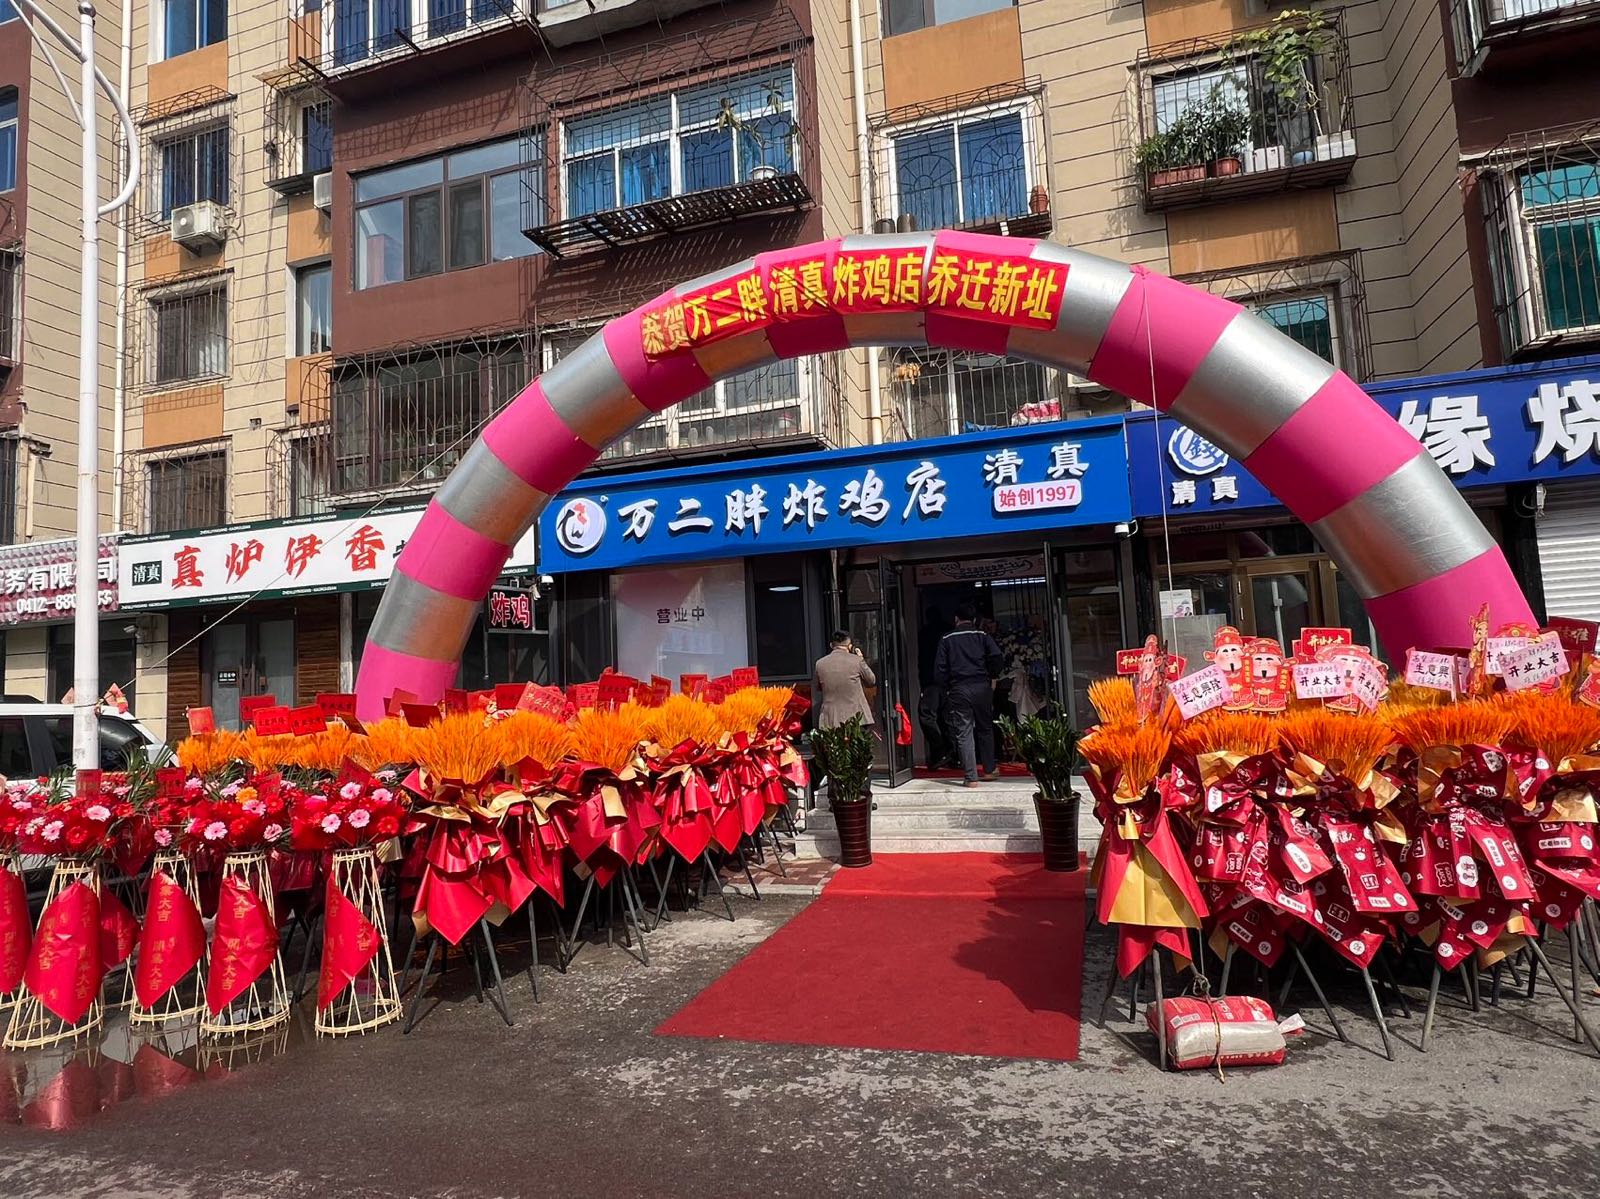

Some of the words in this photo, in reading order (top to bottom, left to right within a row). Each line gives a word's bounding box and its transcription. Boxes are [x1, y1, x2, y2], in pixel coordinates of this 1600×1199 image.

[642, 252, 1059, 355] 恭贺万二胖清真炸鸡店乔迁新址
[983, 441, 1090, 485] 清真
[617, 461, 948, 539] 万二胖炸鸡店
[999, 485, 1077, 508] 始创1997
[1172, 475, 1239, 505] 清真
[133, 563, 161, 583] 清真
[171, 524, 386, 590] 真炉伊香
[0, 557, 118, 595] 务有限司
[490, 591, 530, 629] 炸鸡
[656, 605, 705, 624] 营业中
[1299, 674, 1341, 687] 开业大吉
[1508, 651, 1560, 678] 开业大吉
